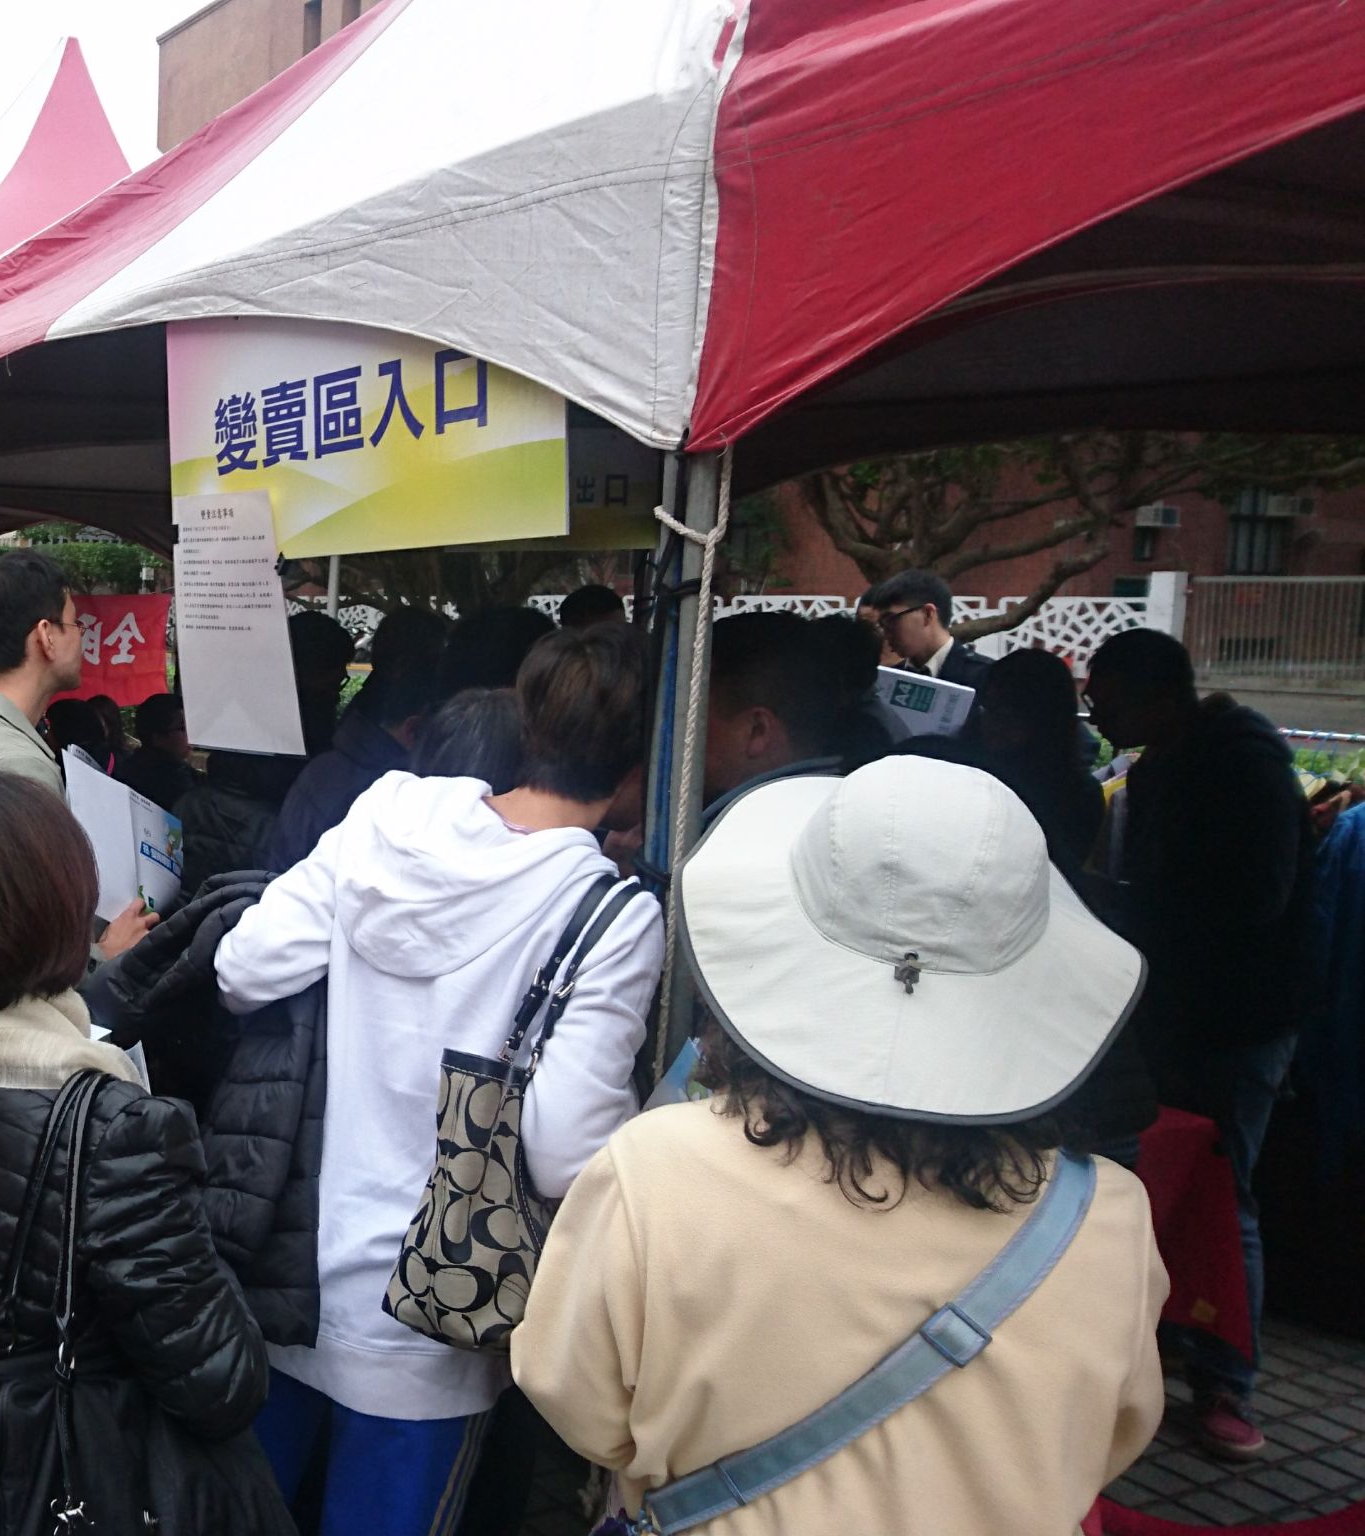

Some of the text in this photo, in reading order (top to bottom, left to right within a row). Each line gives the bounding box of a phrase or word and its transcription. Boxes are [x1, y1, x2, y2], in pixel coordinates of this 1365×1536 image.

[215, 348, 488, 476] 變賣區入口
[576, 474, 629, 506] 出口
[893, 682, 913, 707] A4
